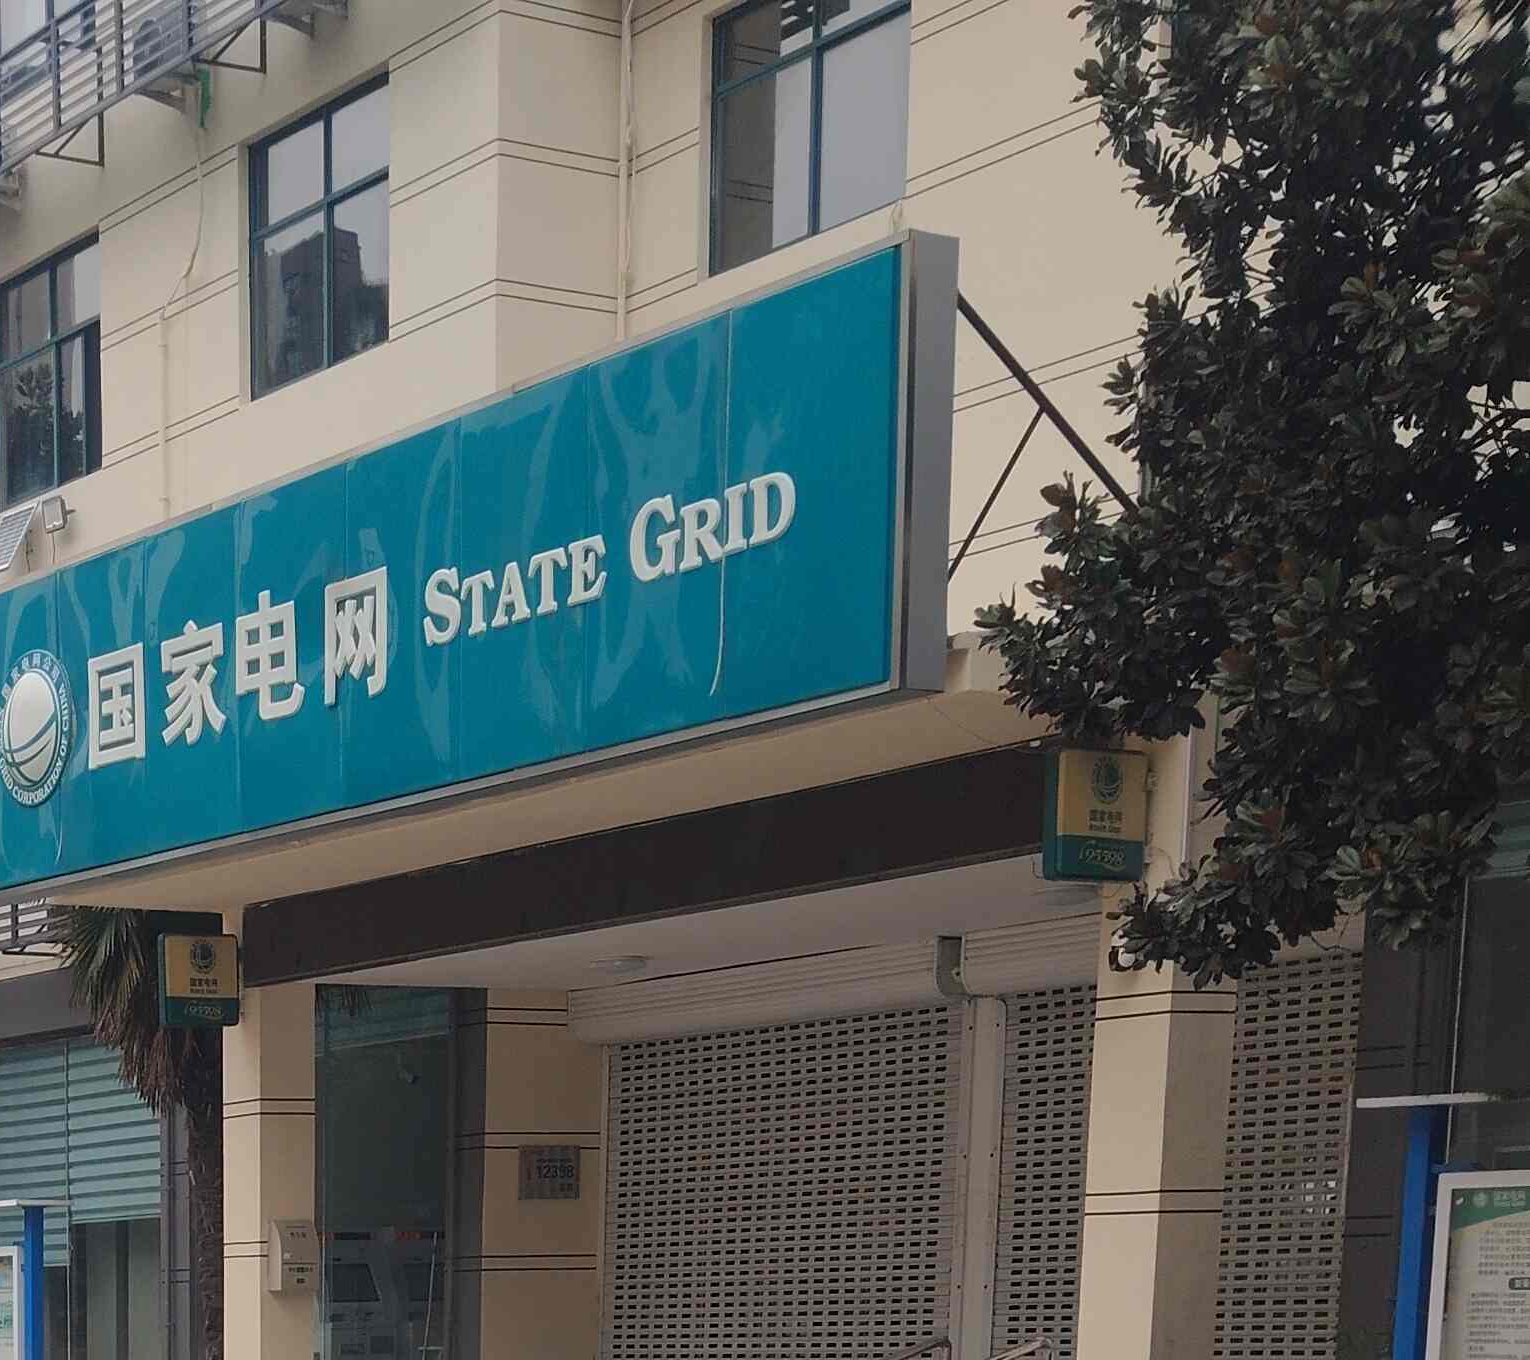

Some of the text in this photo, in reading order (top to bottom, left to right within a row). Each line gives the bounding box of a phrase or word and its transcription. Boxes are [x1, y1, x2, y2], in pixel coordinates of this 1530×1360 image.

[423, 471, 797, 648] STATE GRID
[88, 566, 388, 771] 国家电网
